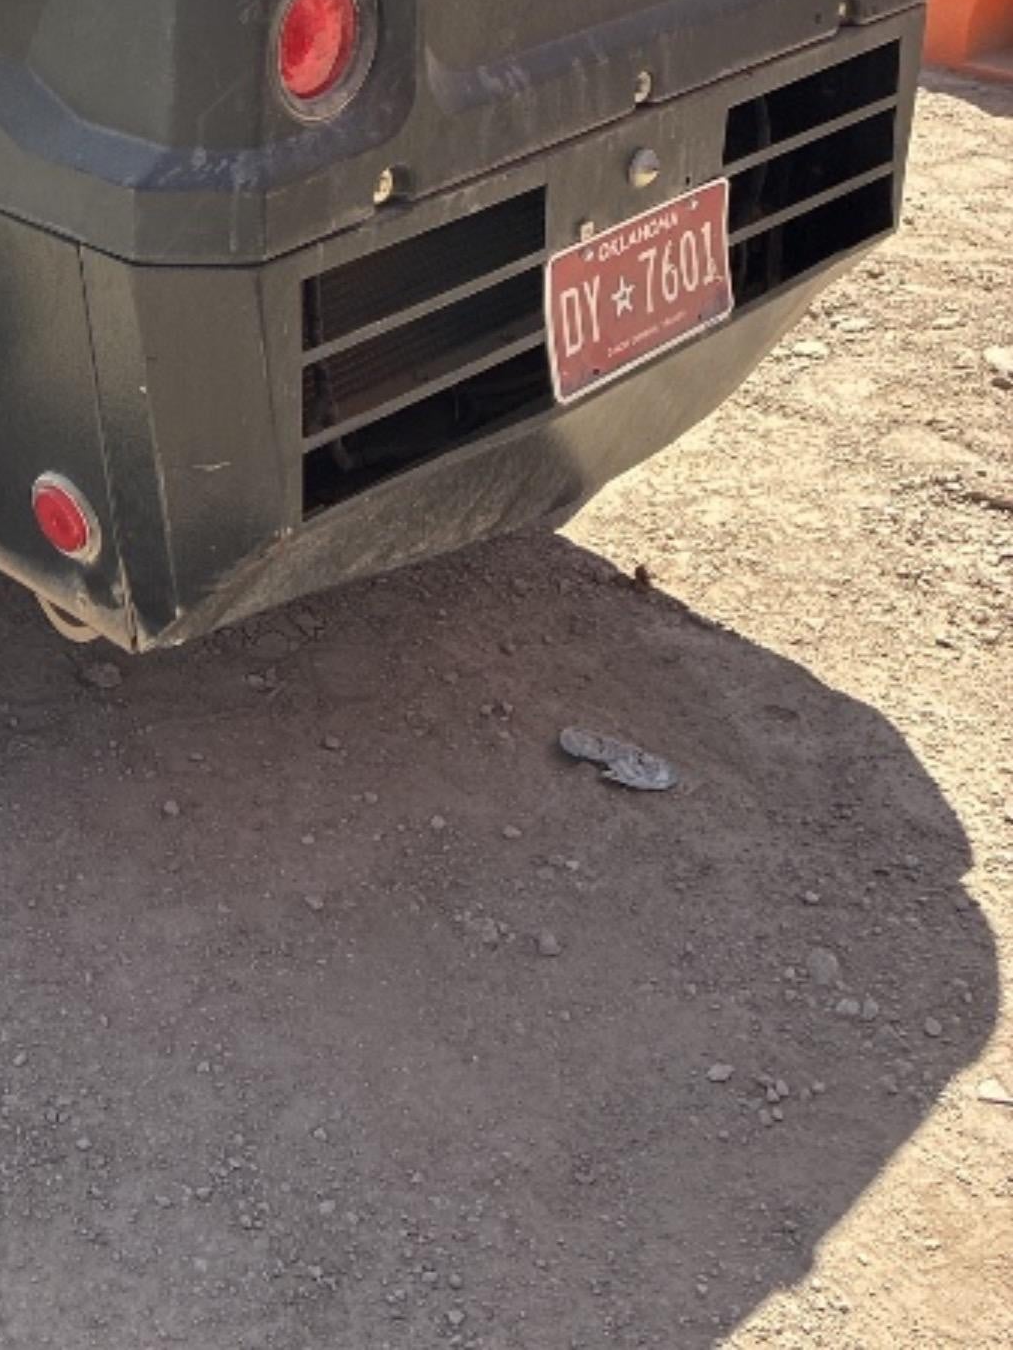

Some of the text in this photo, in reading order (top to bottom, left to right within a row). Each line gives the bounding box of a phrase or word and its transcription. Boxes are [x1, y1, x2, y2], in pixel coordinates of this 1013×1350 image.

[598, 212, 679, 262] OKLAHOMA
[559, 274, 601, 358] DY
[638, 221, 724, 314] 7601
